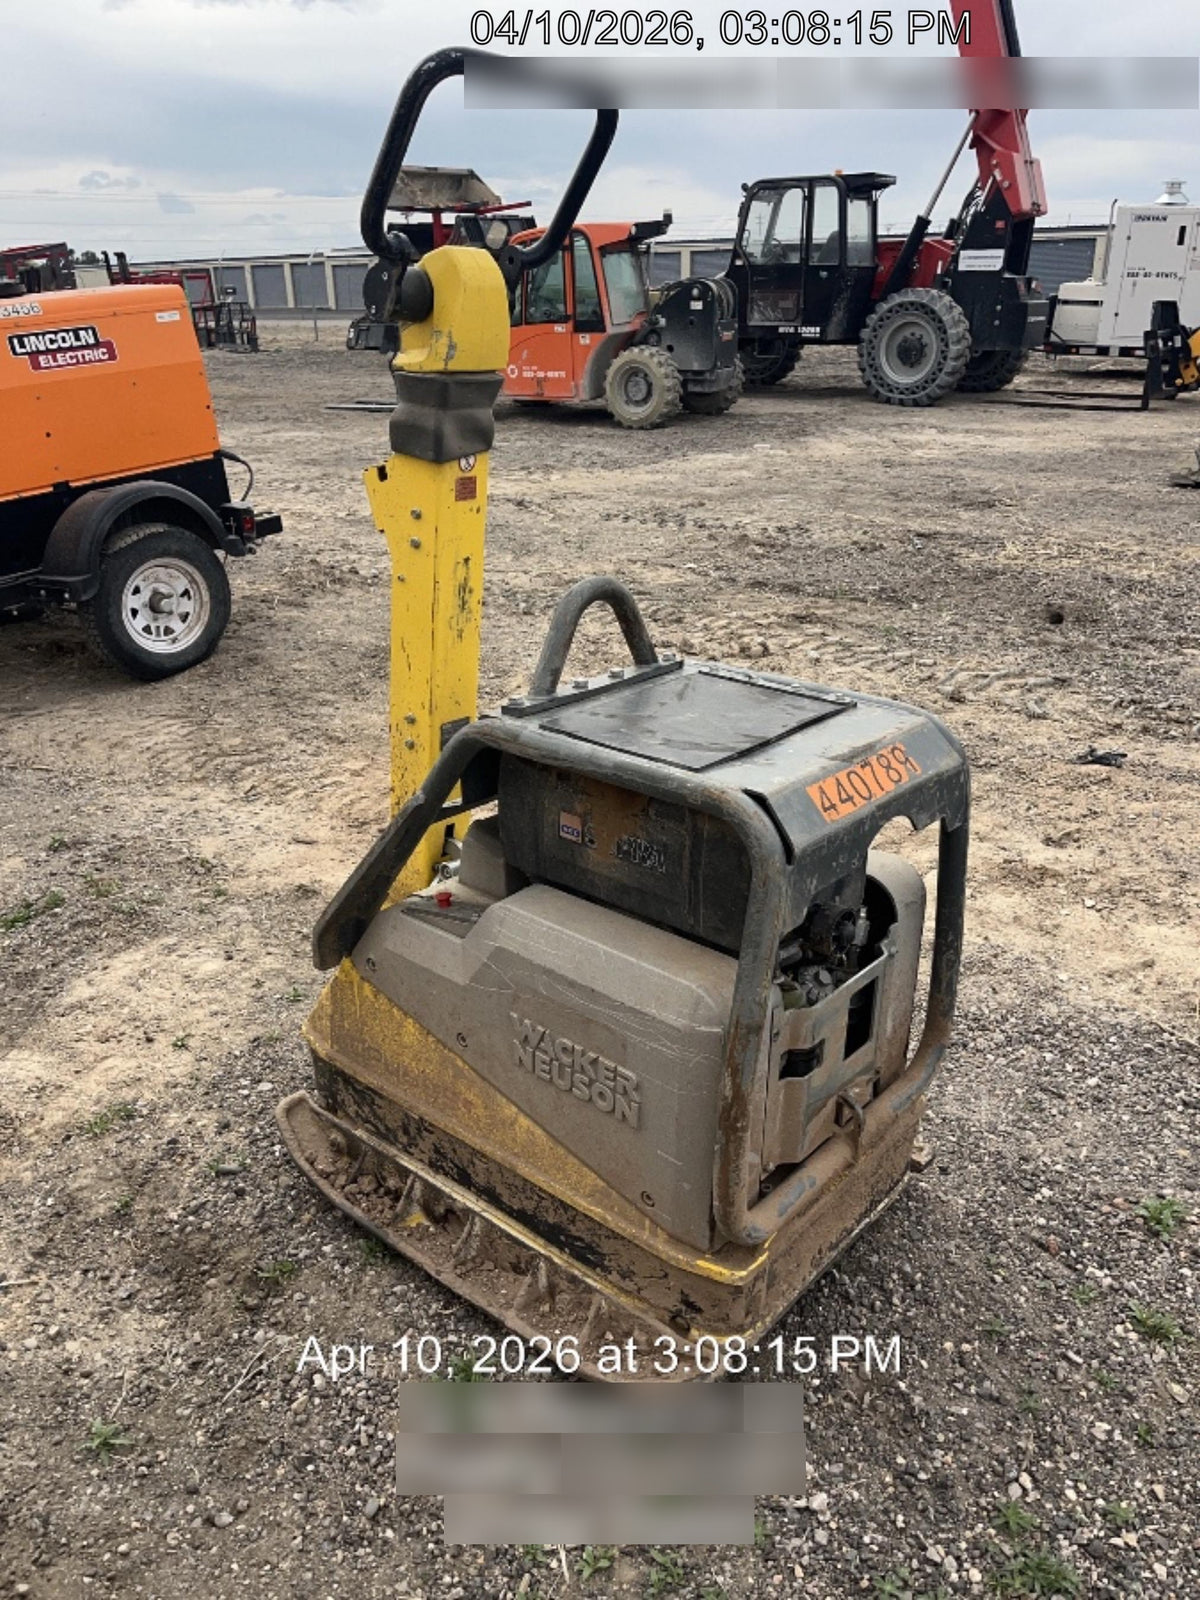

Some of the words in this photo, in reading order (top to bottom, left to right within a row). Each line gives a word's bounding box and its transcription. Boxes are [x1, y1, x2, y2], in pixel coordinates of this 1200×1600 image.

[11, 329, 96, 354] LINCOLN
[39, 348, 109, 368] ELECTRIC
[818, 745, 919, 816] 440789
[509, 1011, 641, 1103] WACKER
[513, 1039, 641, 1130] NEUSON
